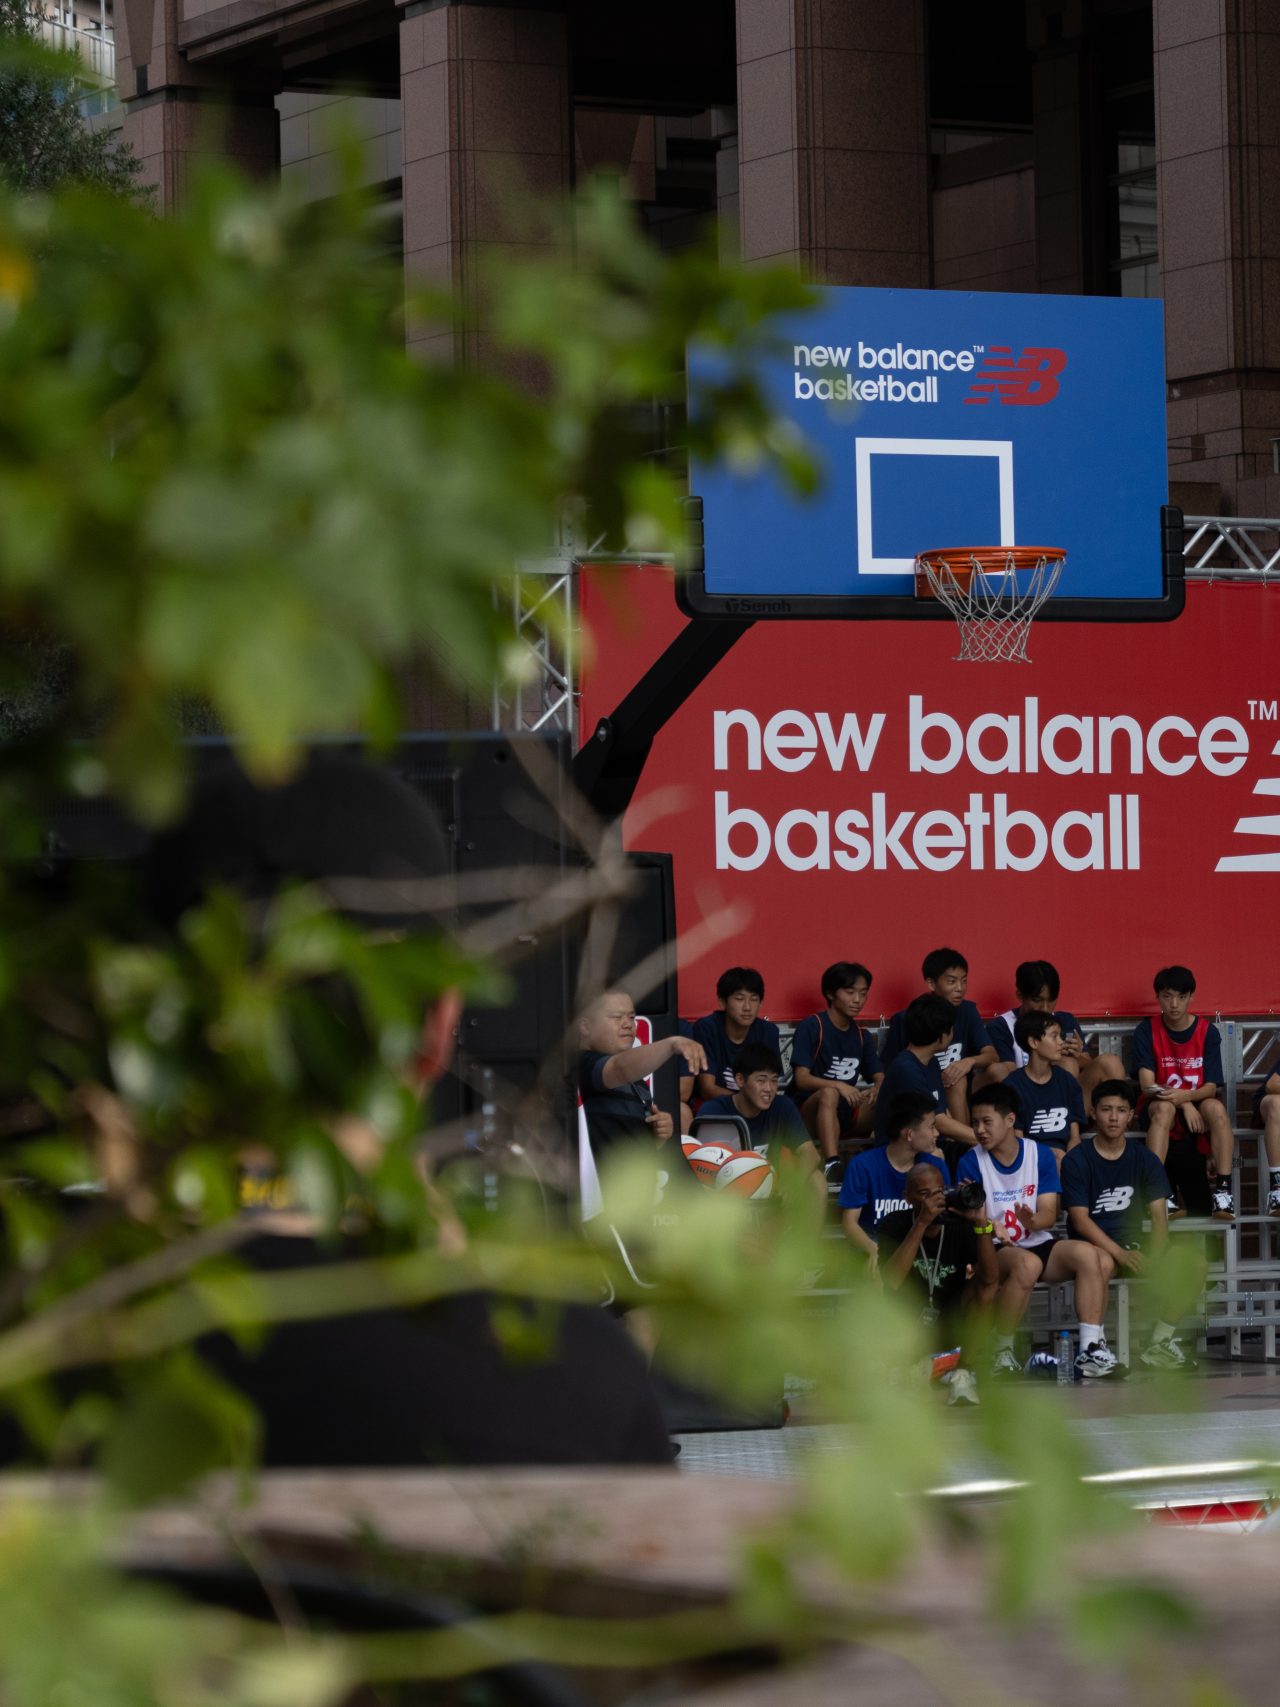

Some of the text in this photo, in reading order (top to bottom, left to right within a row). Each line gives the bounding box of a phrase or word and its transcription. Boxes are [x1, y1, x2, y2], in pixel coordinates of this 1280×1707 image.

[793, 345, 852, 368] new
[857, 341, 975, 372] balance
[793, 372, 939, 403] basketball
[713, 708, 887, 774] new
[908, 694, 1251, 777] balance
[713, 790, 1142, 873] basketball
